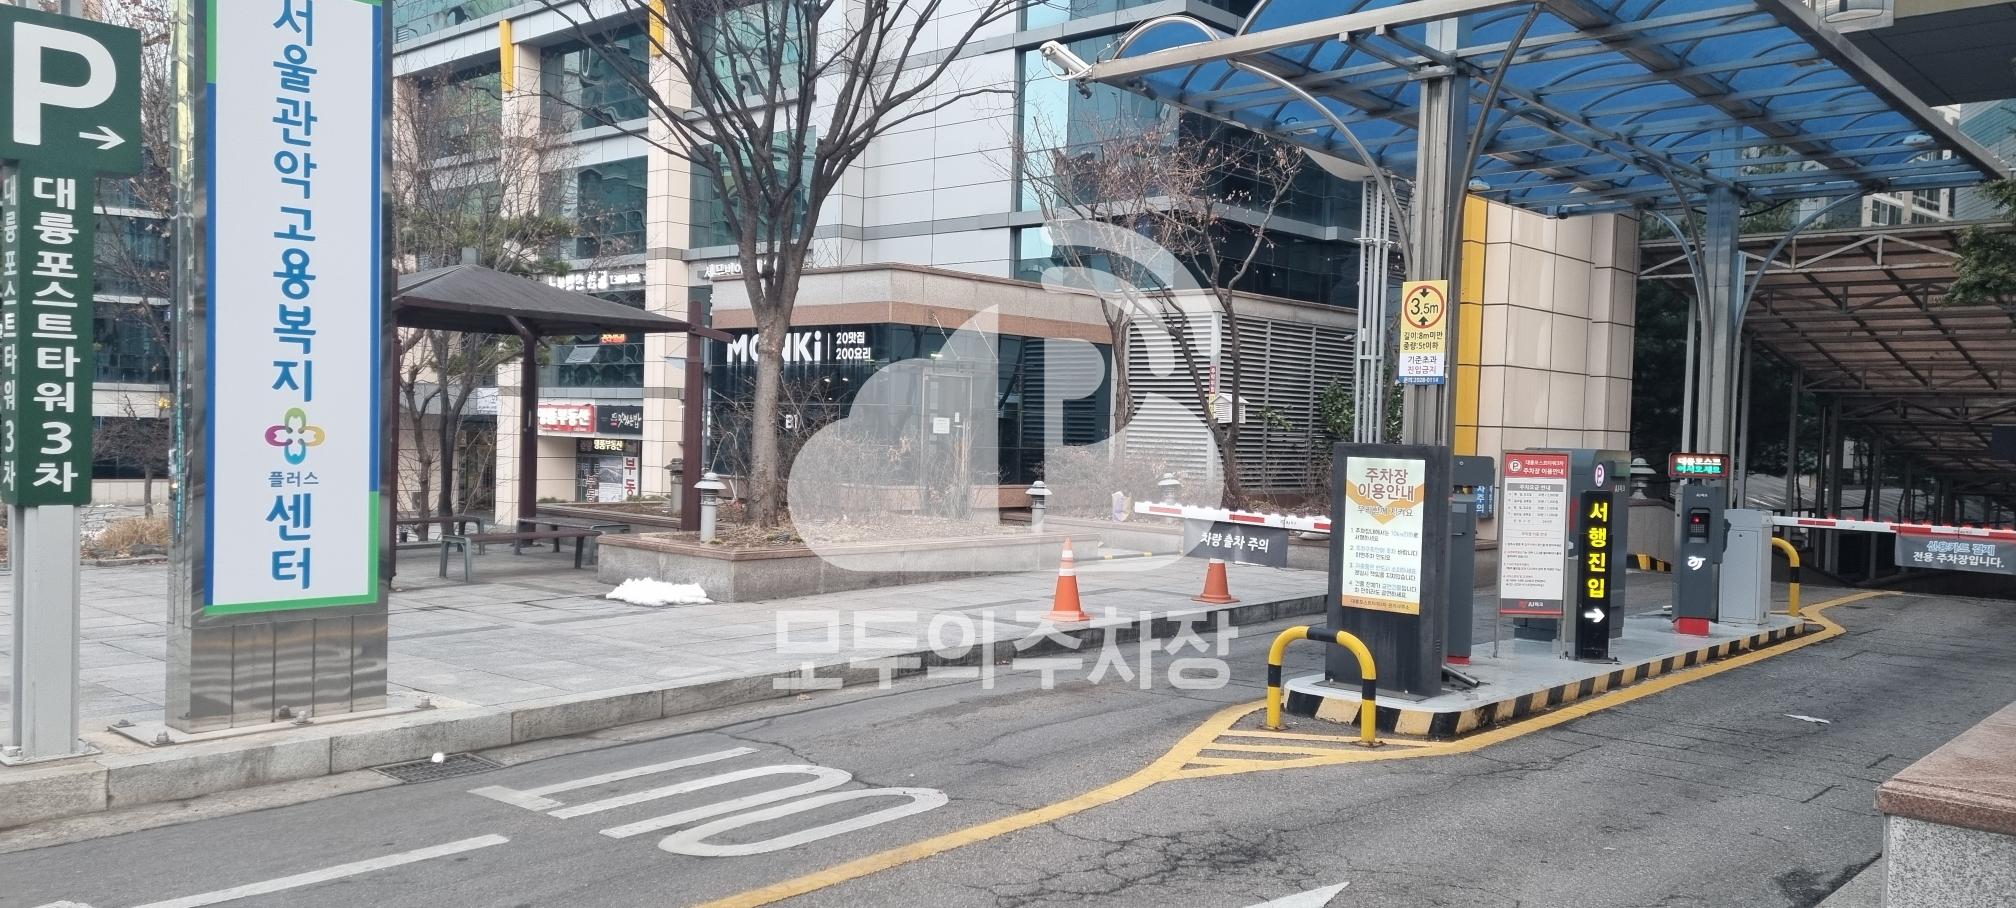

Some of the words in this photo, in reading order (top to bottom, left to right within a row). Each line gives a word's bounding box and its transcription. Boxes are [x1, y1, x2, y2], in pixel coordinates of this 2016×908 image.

[13, 21, 117, 146] P
[1410, 297, 1439, 316] 3.5m
[32, 176, 81, 493] 대륭포스트타워3차
[835, 330, 865, 345] 20맛집
[835, 346, 872, 361] 200요리
[1407, 365, 1437, 375] 진입금지
[785, 414, 799, 429] B1
[593, 439, 624, 451] 명품부동산
[268, 470, 320, 488] 플러스
[1364, 467, 1409, 485] 주차장
[1357, 482, 1415, 502] 이용안내
[266, 492, 313, 590] 센터
[1200, 531, 1222, 548] 차량
[1223, 534, 1245, 551] 출차
[1247, 536, 1269, 554] 주의
[1926, 540, 1971, 554] 신용카드
[1971, 543, 1996, 557] 결제
[1587, 502, 1608, 599] 서행진입
[1912, 551, 1934, 563] 전용
[1936, 552, 2005, 569] 주차장입니다.
